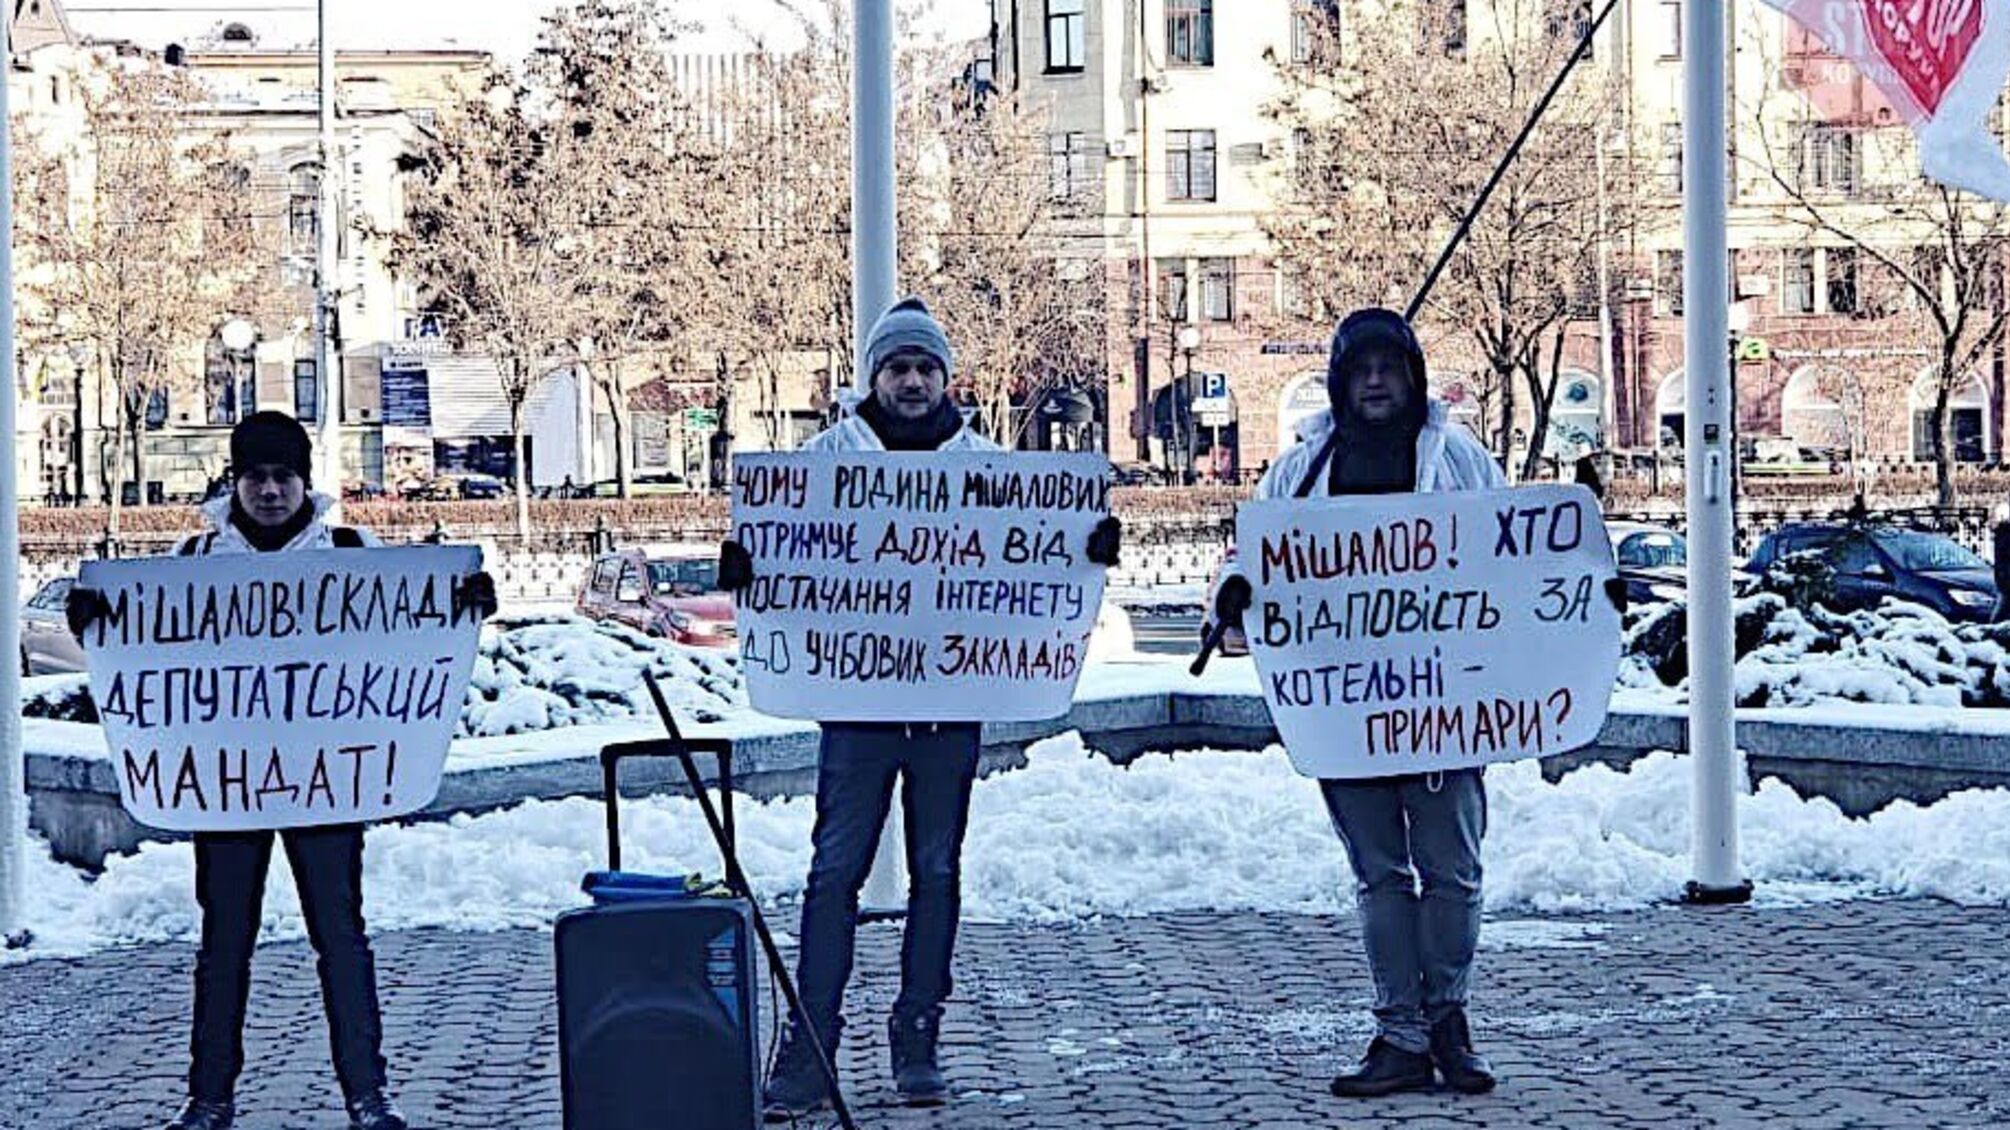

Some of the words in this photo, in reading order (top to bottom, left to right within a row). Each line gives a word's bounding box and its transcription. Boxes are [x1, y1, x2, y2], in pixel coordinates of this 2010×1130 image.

[1207, 374, 1221, 397] P
[736, 465, 808, 508] ЧОМУ
[833, 464, 950, 513] РОДИНА
[738, 519, 861, 564] ОТРИМУЄ
[874, 522, 987, 567] ДОХІД
[1002, 520, 1074, 567] ВІД
[1494, 500, 1583, 557] ХТО
[1533, 573, 1594, 624] ЗА
[743, 627, 791, 674] ДО
[806, 629, 928, 684] УЧБОВИХ
[101, 656, 455, 729] ДЕПУТАТСЬКИЙ
[1366, 686, 1572, 756] ПРИМАРИ?
[122, 740, 397, 812] МАНДАТ!
